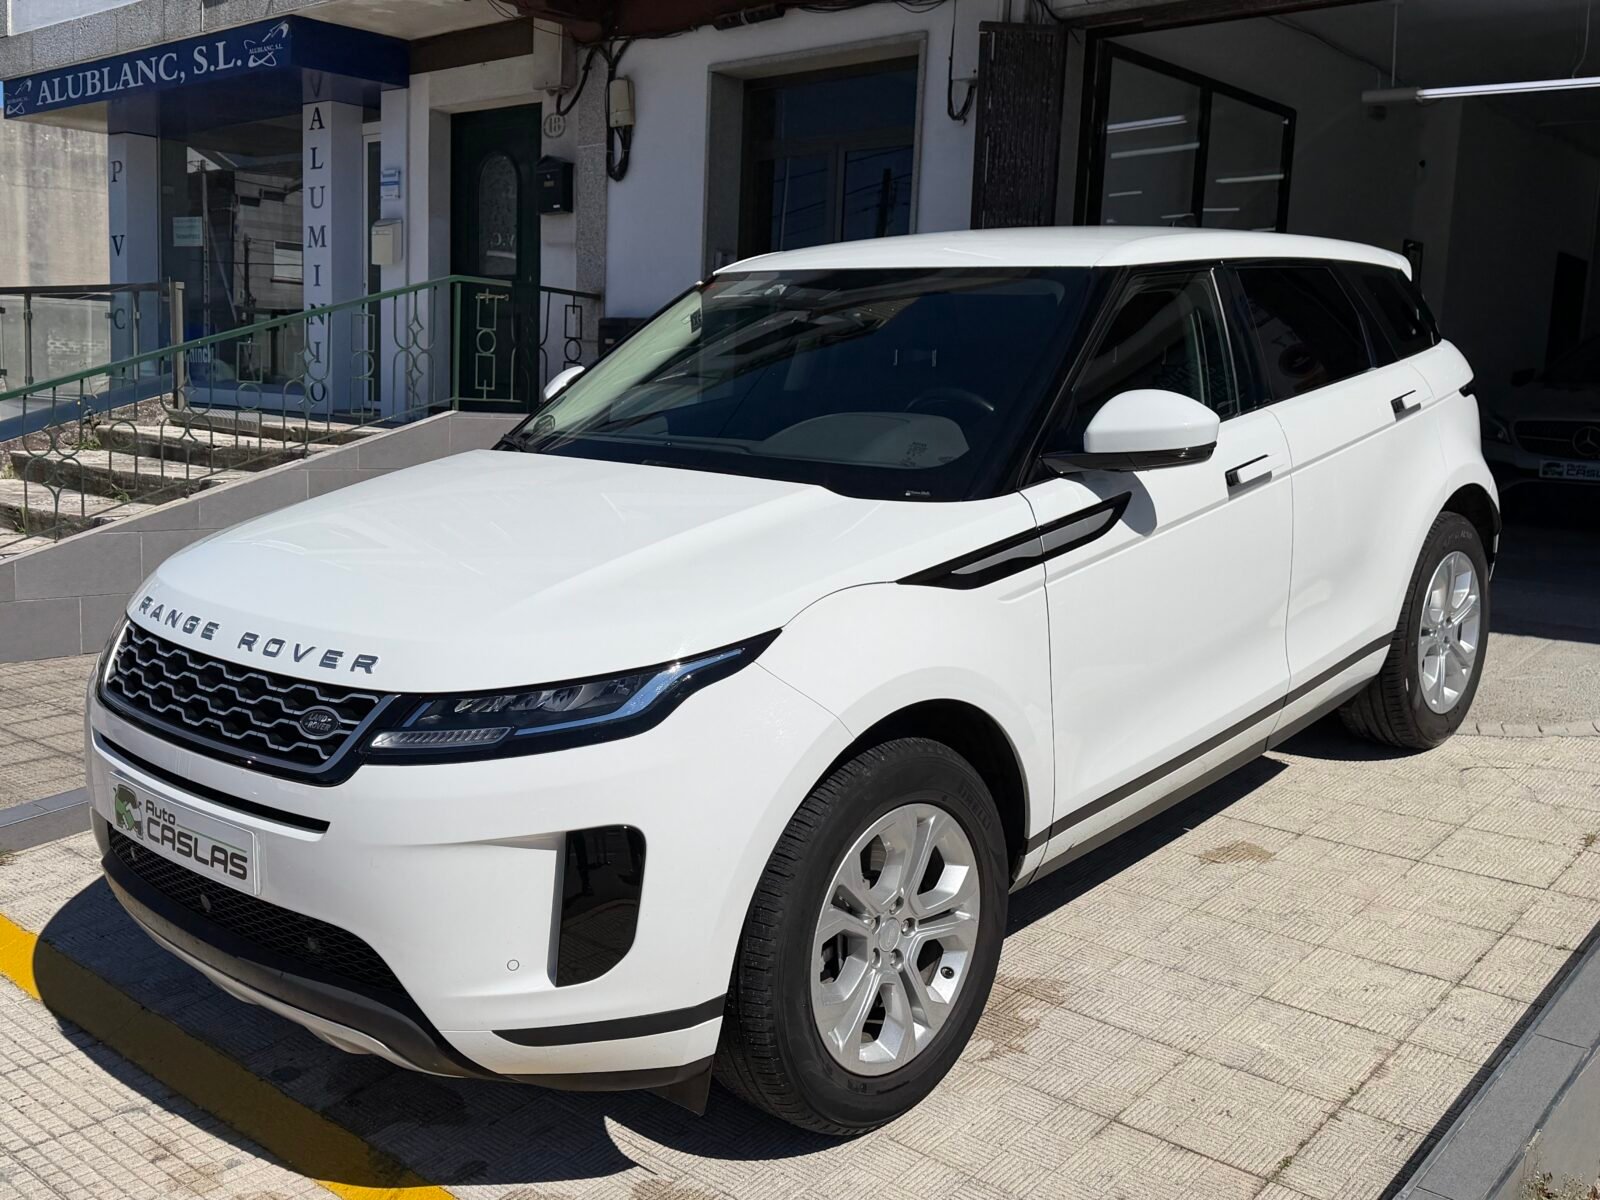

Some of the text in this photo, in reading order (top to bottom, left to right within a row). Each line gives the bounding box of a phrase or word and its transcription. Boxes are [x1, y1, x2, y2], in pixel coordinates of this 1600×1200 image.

[36, 41, 242, 106] ALUBLANC, S.L.
[138, 596, 380, 675] RANGE ROVER
[307, 720, 331, 732] ROVER
[145, 799, 176, 825] Auto
[147, 816, 248, 881] CASLAS
